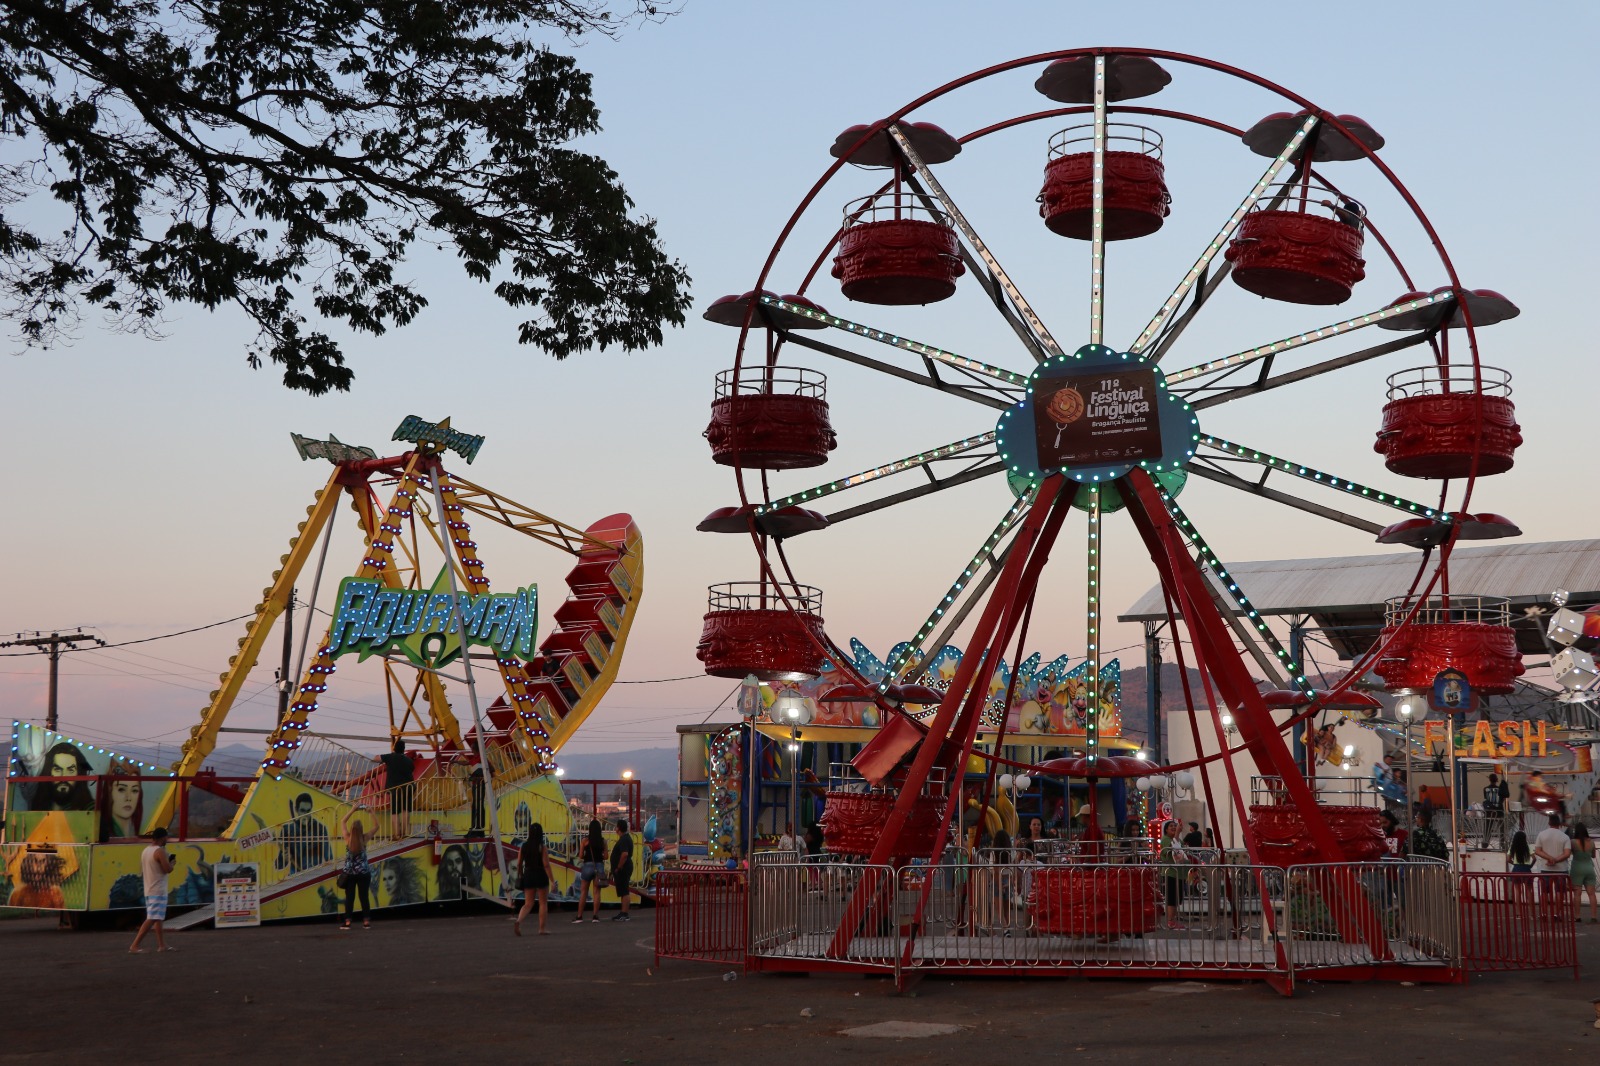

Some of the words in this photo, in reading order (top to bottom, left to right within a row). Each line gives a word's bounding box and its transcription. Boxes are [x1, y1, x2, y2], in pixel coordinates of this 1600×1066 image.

[1091, 386, 1143, 404] Festival
[1087, 401, 1149, 419] Linguiça
[329, 581, 538, 654] AQUAMAN
[241, 831, 271, 848] ENTRADA
